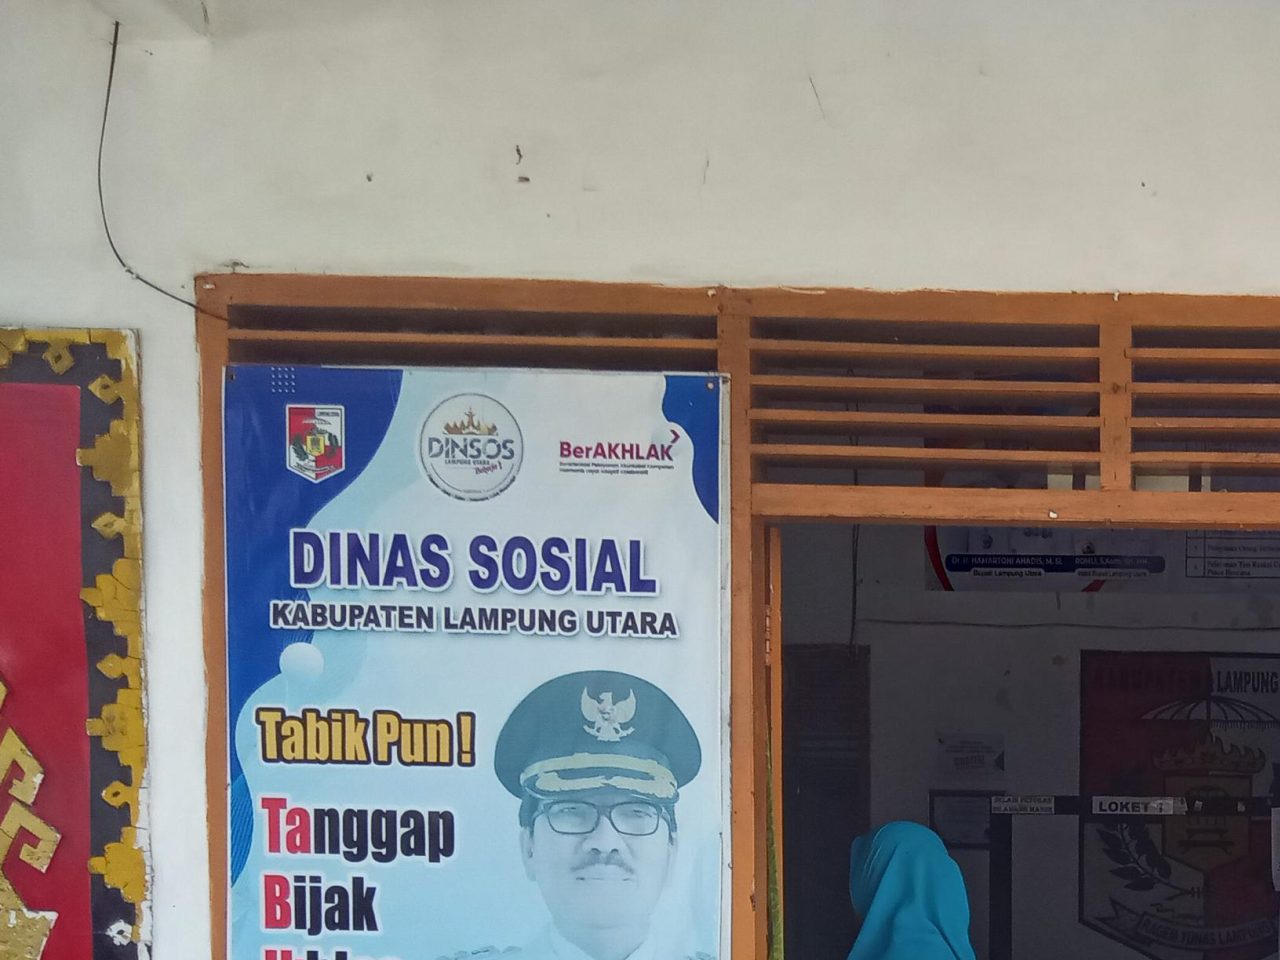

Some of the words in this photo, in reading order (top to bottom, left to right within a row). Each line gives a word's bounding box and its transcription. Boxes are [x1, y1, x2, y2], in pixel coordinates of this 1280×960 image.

[428, 437, 515, 460] DINSOS
[559, 441, 674, 461] BerAKHLAK
[291, 529, 451, 590] DINAS
[467, 535, 657, 594] SOSIAL
[271, 603, 435, 630] KABUPATEN
[444, 606, 578, 634] LAMPUNG
[586, 611, 678, 637] UTARA
[1216, 670, 1280, 694] LAMPUNG
[256, 708, 370, 764] Tabik
[372, 711, 454, 767] Pun
[1098, 801, 1151, 813] LOKET
[261, 797, 456, 863] Tanggap
[263, 874, 380, 935] Bijak
